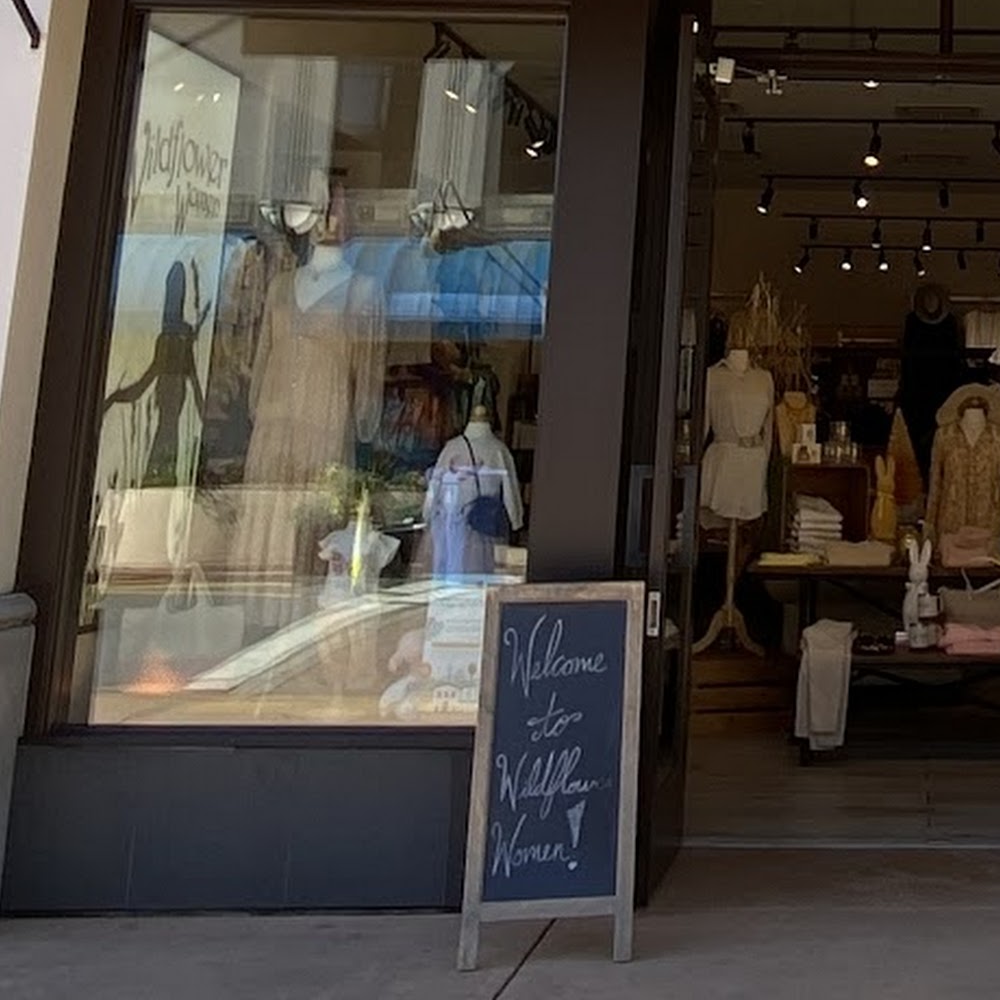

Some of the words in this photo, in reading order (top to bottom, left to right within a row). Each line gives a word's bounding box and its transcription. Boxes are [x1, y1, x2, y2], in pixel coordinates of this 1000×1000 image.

[503, 613, 608, 697] Welcome
[526, 692, 583, 742] to
[491, 802, 586, 879] Women!
